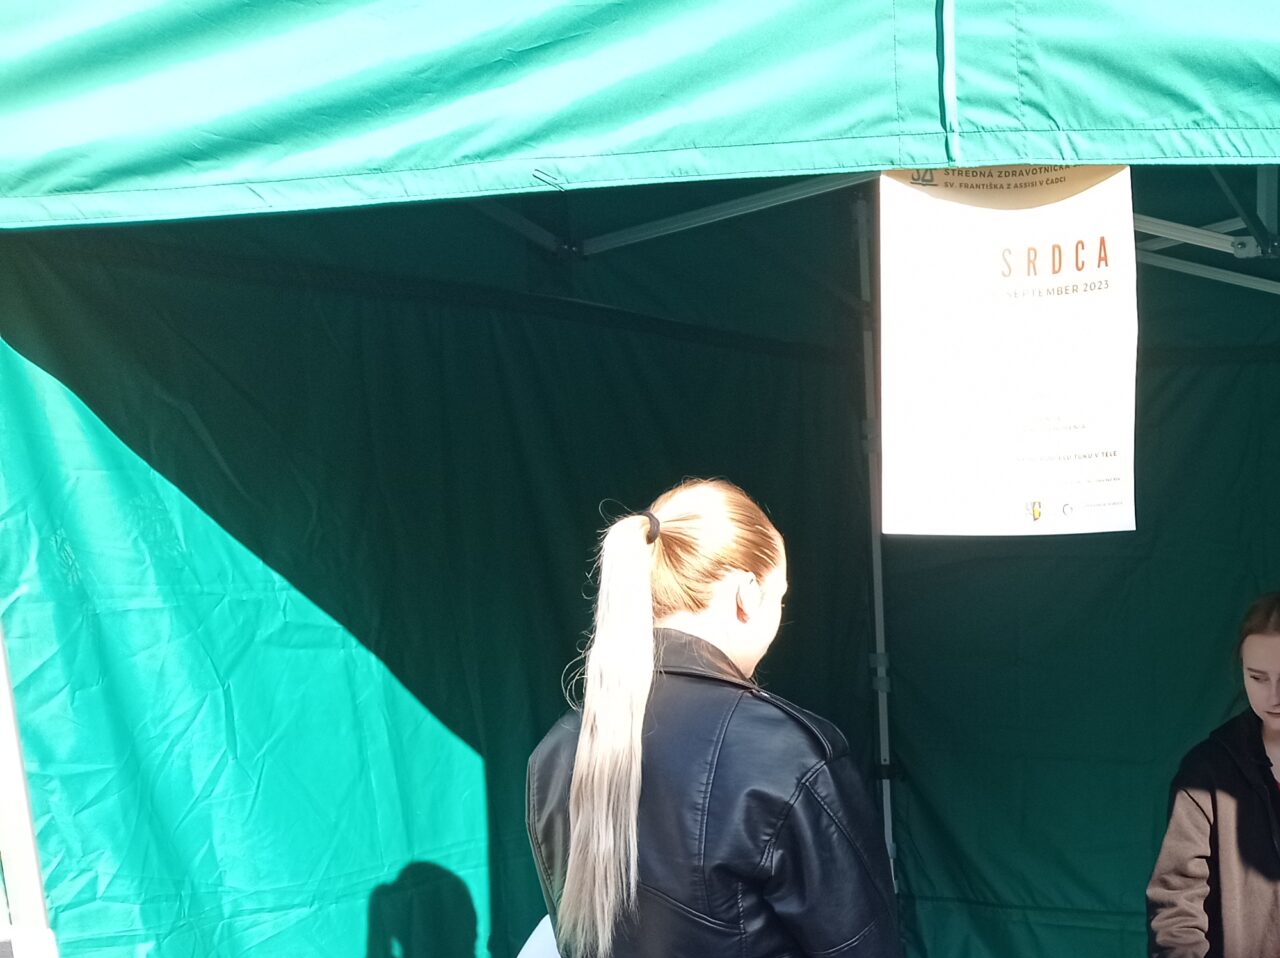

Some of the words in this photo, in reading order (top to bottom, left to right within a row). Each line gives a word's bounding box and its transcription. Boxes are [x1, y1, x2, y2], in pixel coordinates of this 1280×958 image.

[959, 181, 1004, 189] FRANTIŠKA
[1013, 181, 1037, 189] ASSISI
[1001, 236, 1108, 277] SRDCA
[1083, 279, 1109, 292] 2023
